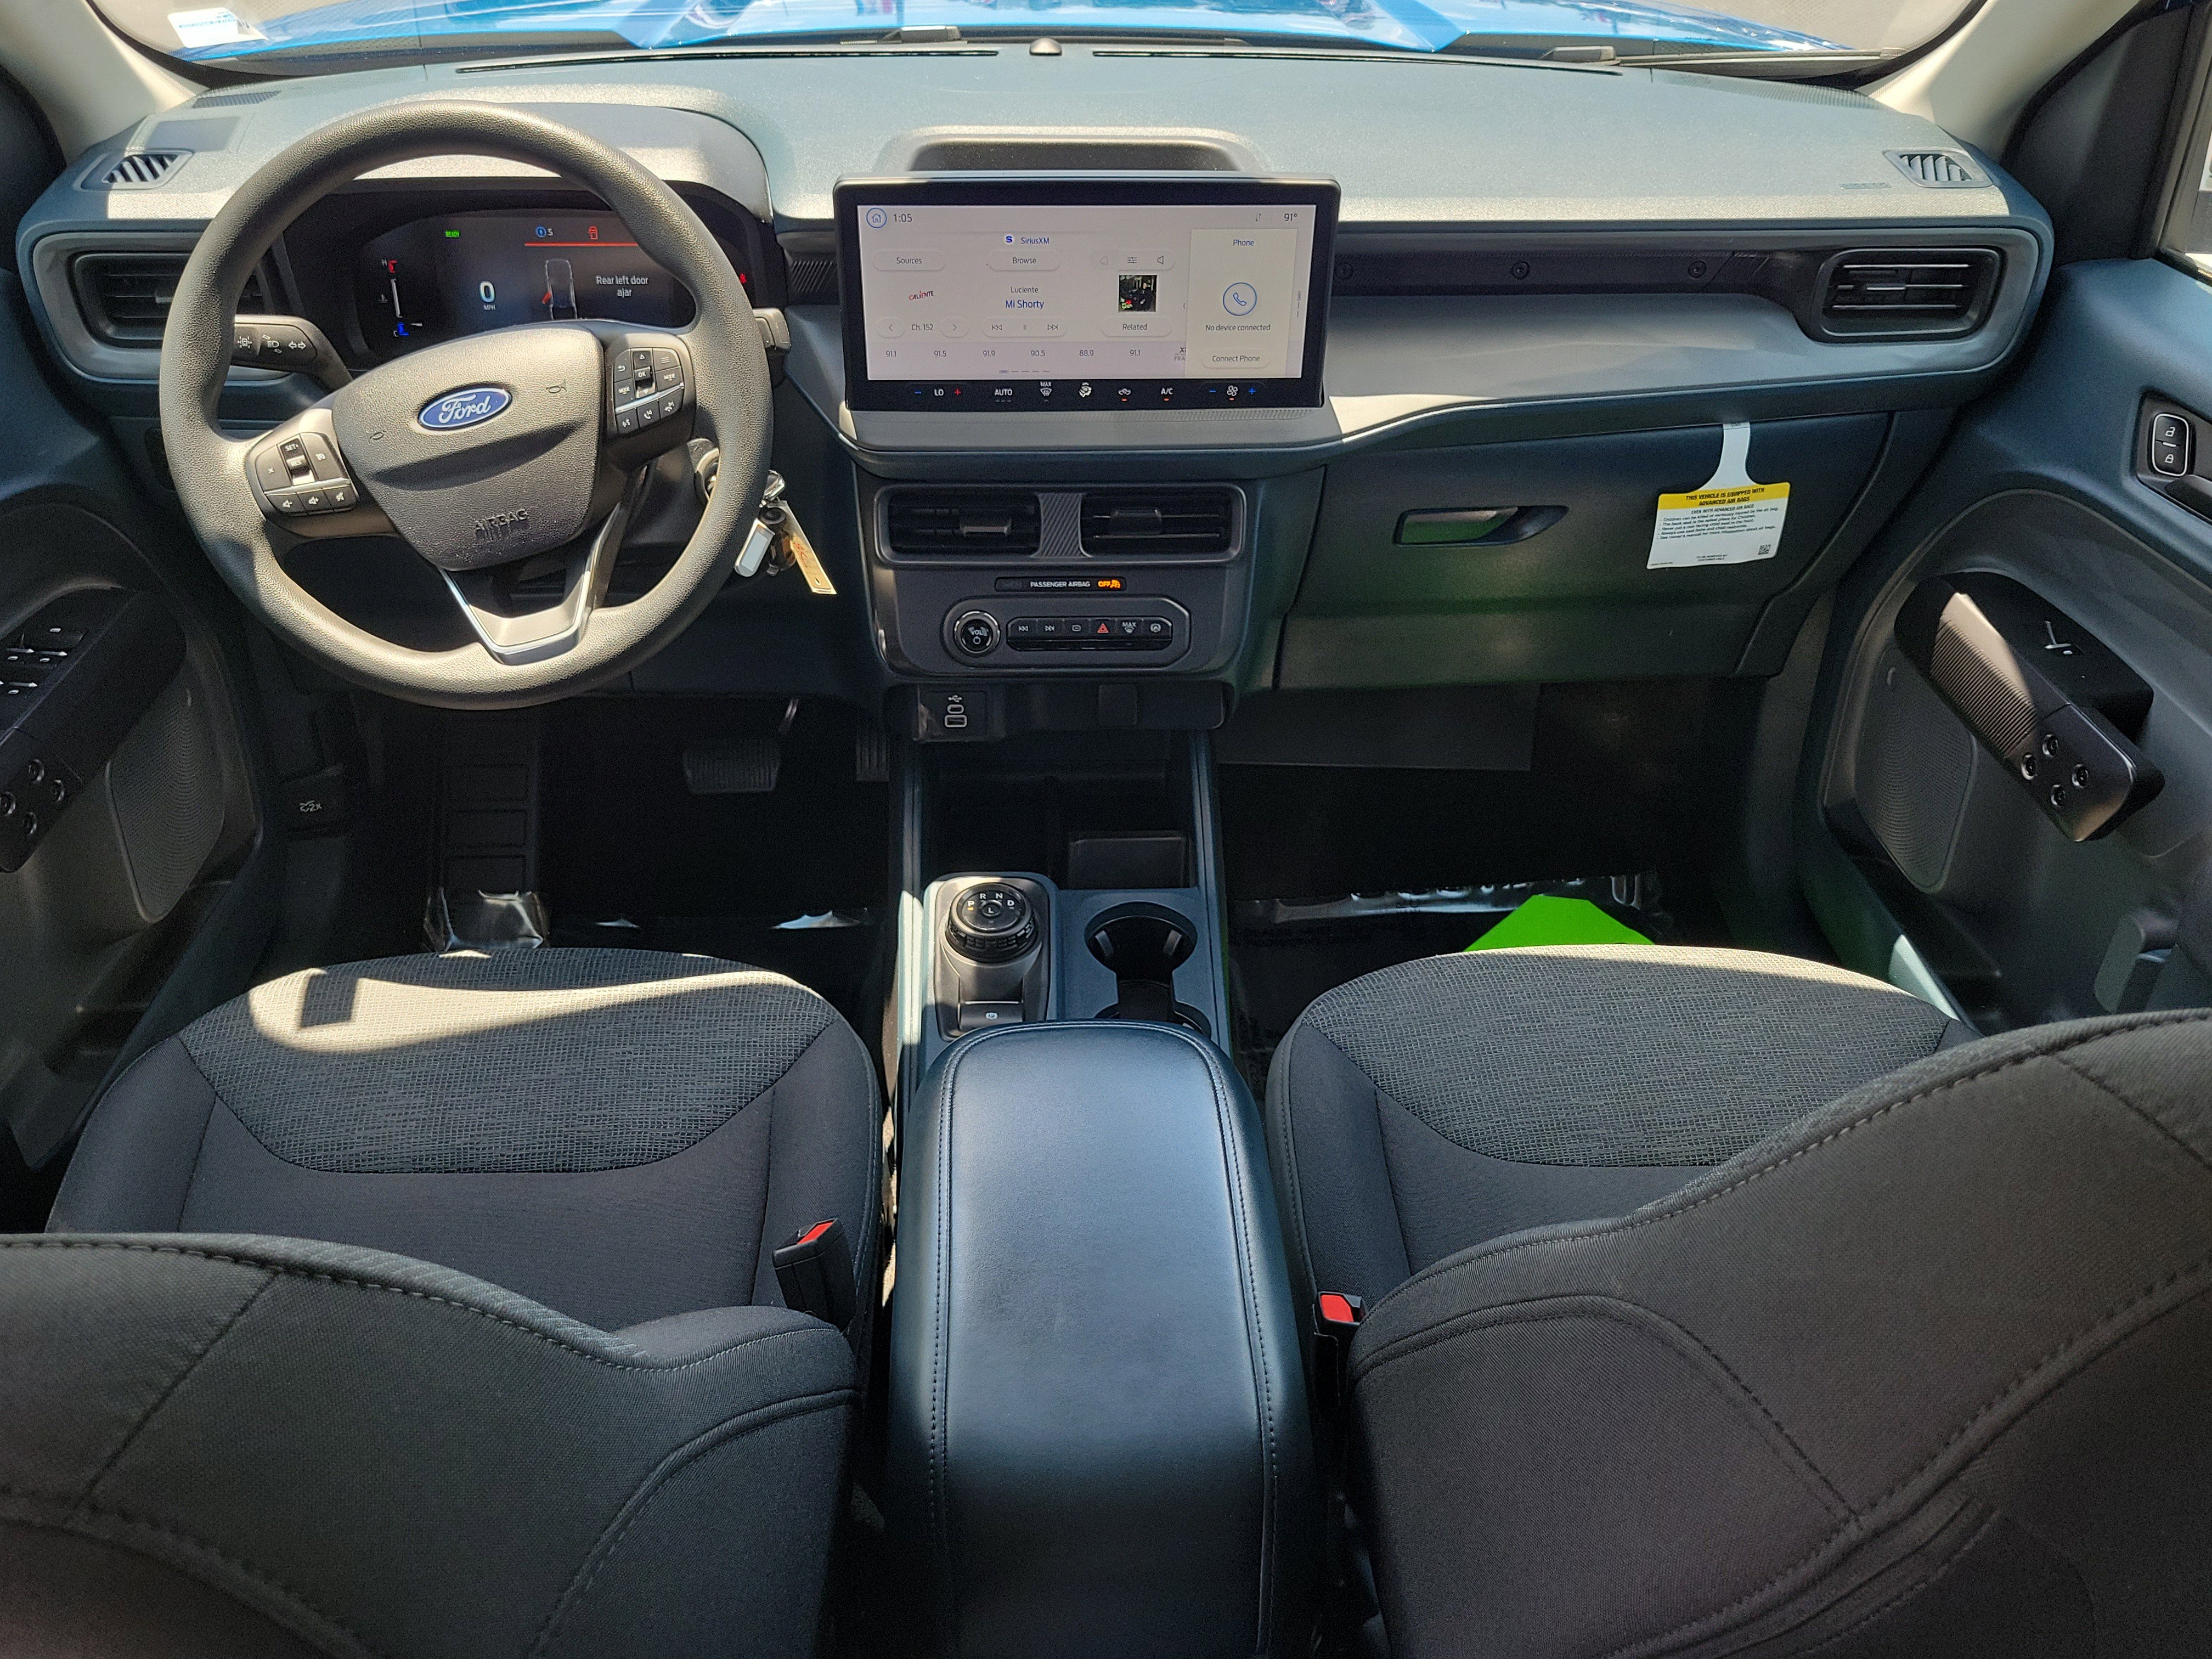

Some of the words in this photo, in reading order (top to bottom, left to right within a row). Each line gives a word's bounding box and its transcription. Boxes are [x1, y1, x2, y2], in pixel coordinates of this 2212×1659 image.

[893, 213, 912, 222] 1:05
[1284, 213, 1298, 222] 91°
[596, 275, 614, 285] Rear
[616, 275, 630, 285] left
[630, 275, 648, 285] door
[479, 280, 495, 303] 0
[617, 288, 633, 298] ajar
[1005, 300, 1015, 308] Mi
[1017, 300, 1045, 309] Shorty
[994, 388, 1013, 396] AUTO
[1160, 387, 1173, 396] A/C
[438, 393, 492, 424] Ford
